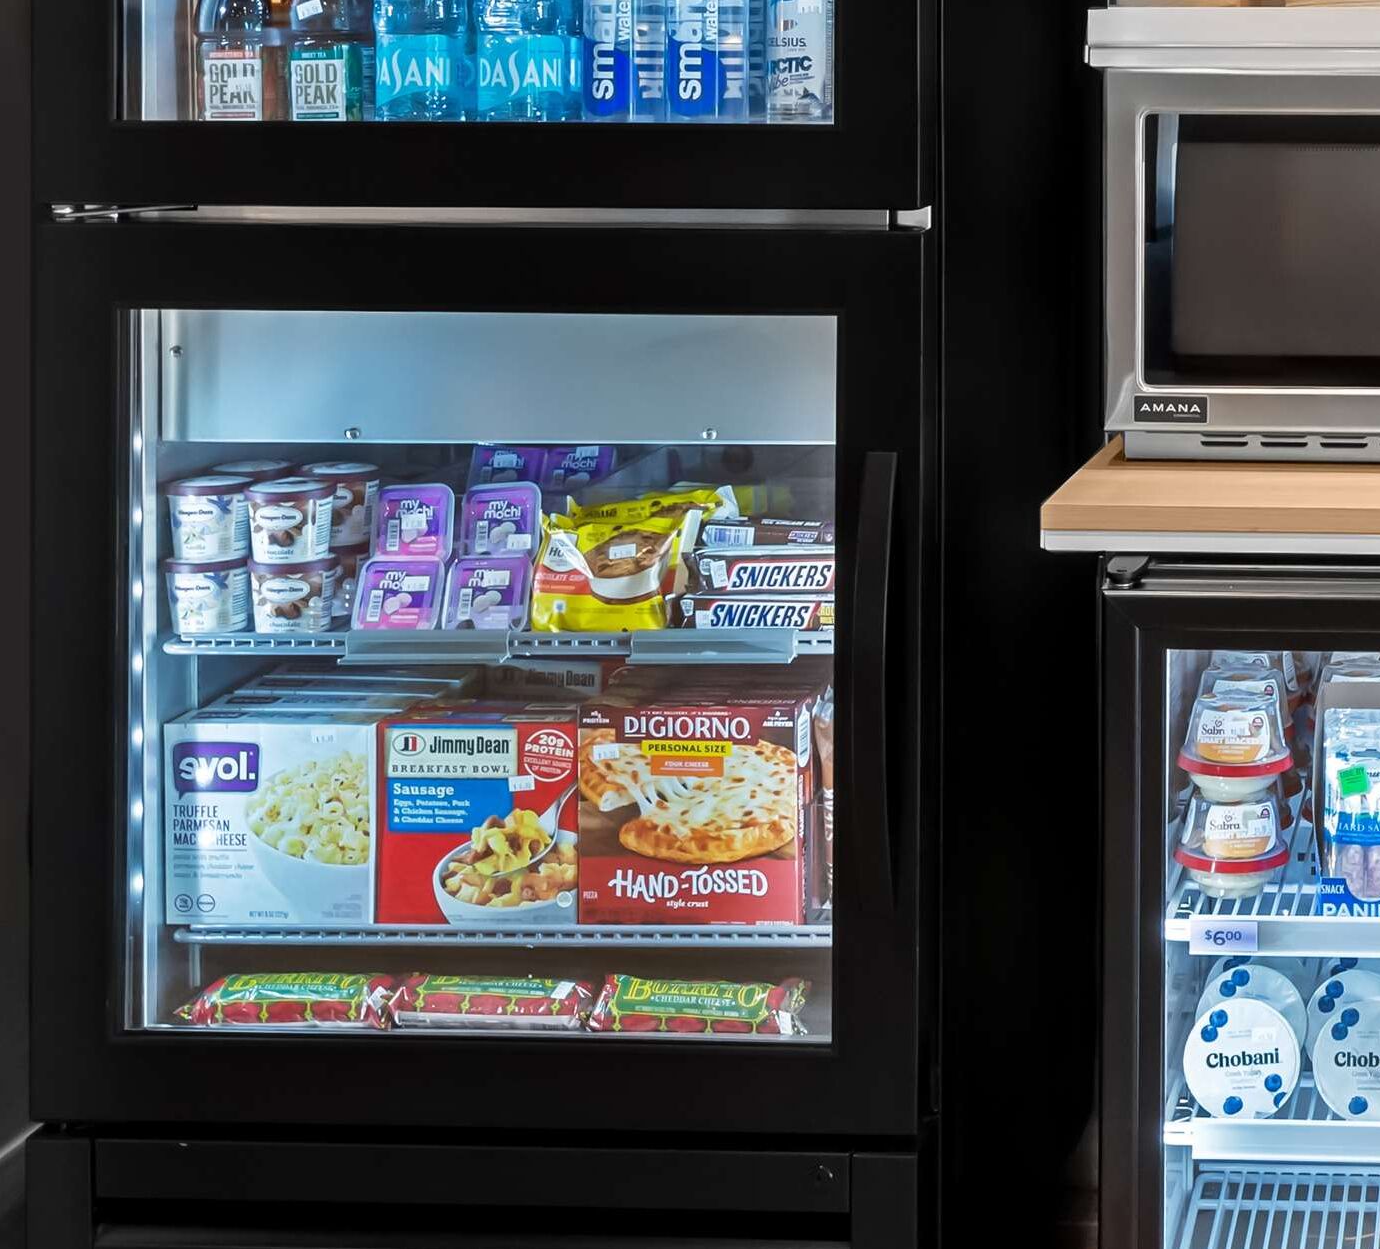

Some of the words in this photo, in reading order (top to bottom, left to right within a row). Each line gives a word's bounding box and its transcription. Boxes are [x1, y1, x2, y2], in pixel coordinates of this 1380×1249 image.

[295, 63, 337, 84] GOLD
[296, 85, 337, 104] PEAK
[1140, 403, 1201, 413] AMANA
[484, 506, 522, 519] mochi
[731, 565, 832, 587] SNICKERS
[710, 604, 811, 627] SNICKERS
[566, 670, 595, 687] Dean
[429, 736, 474, 756] Jimmy
[477, 736, 512, 754] Dean
[538, 735, 565, 747] 20g
[525, 743, 574, 757] PROTEIN
[648, 744, 700, 752] PERSONAL
[704, 744, 726, 753] SIZE
[392, 764, 467, 773] BREAKFAST
[473, 764, 510, 774] BOWL
[393, 783, 454, 798] Sausage
[173, 805, 218, 817] TRUFFLE
[173, 820, 230, 832] PARMESAN
[1209, 820, 1240, 831] Sabra
[173, 834, 196, 846] MAC
[608, 866, 768, 902] HAND-TOSSED
[1321, 885, 1344, 894] SNACK
[666, 899, 685, 909] style
[687, 899, 709, 907] crust
[1206, 1048, 1280, 1069] Chobani
